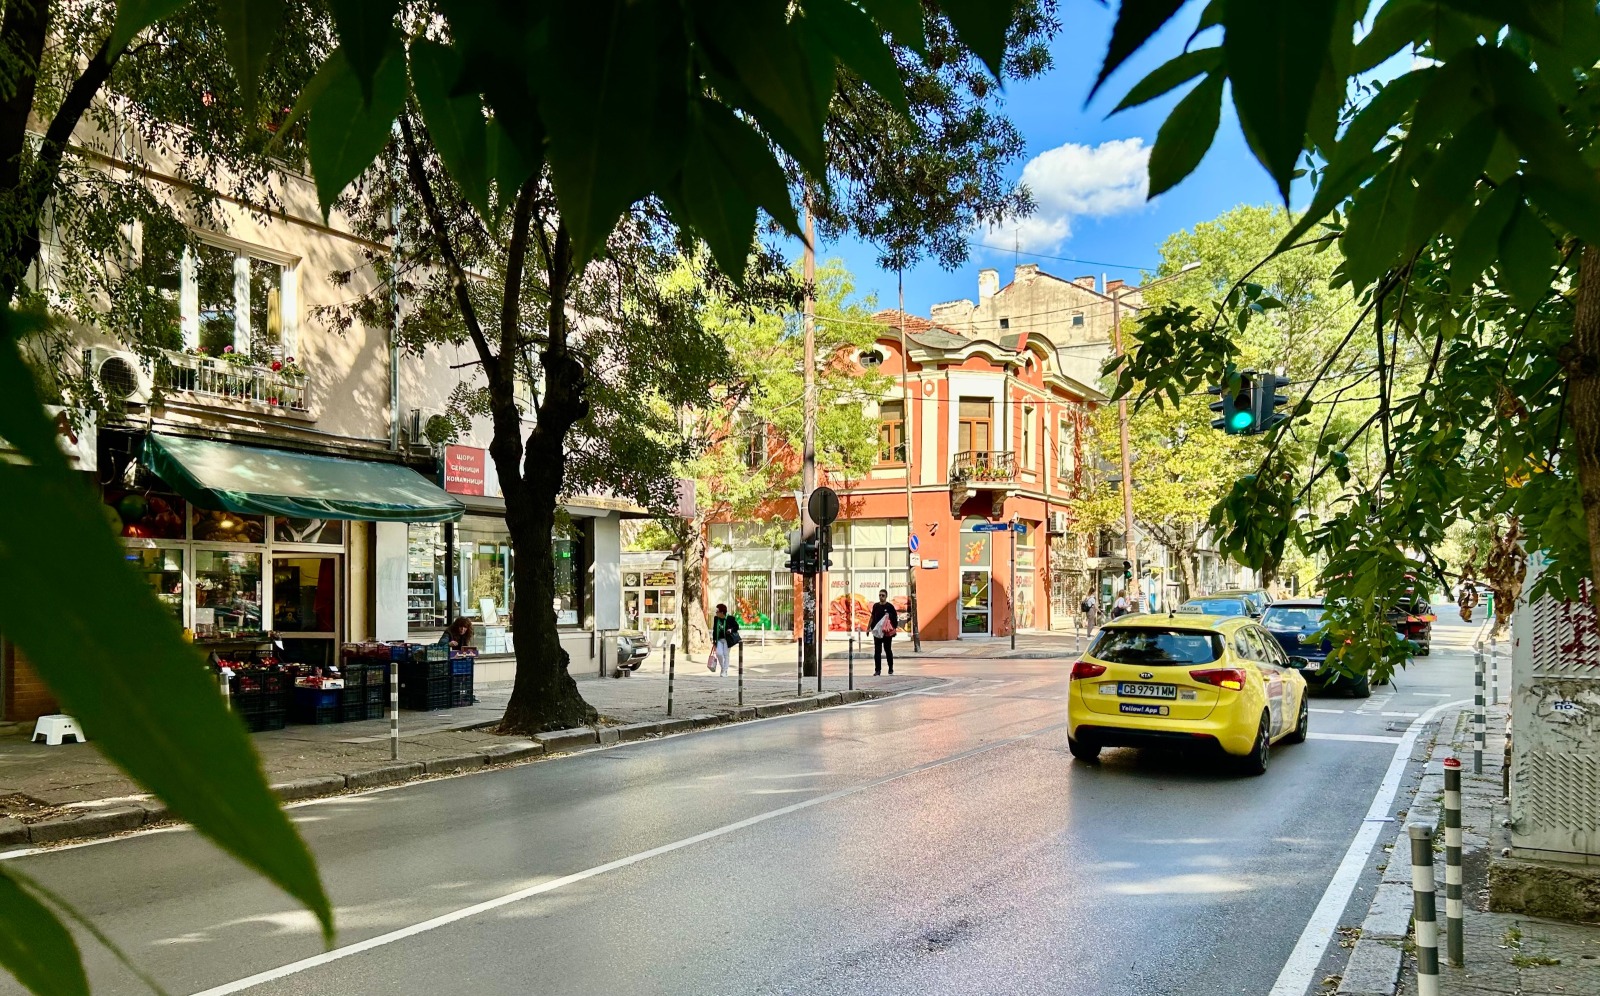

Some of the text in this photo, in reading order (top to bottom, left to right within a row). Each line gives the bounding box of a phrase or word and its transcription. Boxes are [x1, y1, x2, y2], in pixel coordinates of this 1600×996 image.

[451, 465, 480, 474] СЕННИЦИ
[1124, 685, 1136, 693] CB
[1138, 686, 1159, 695] 9791
[1162, 687, 1174, 696] MM
